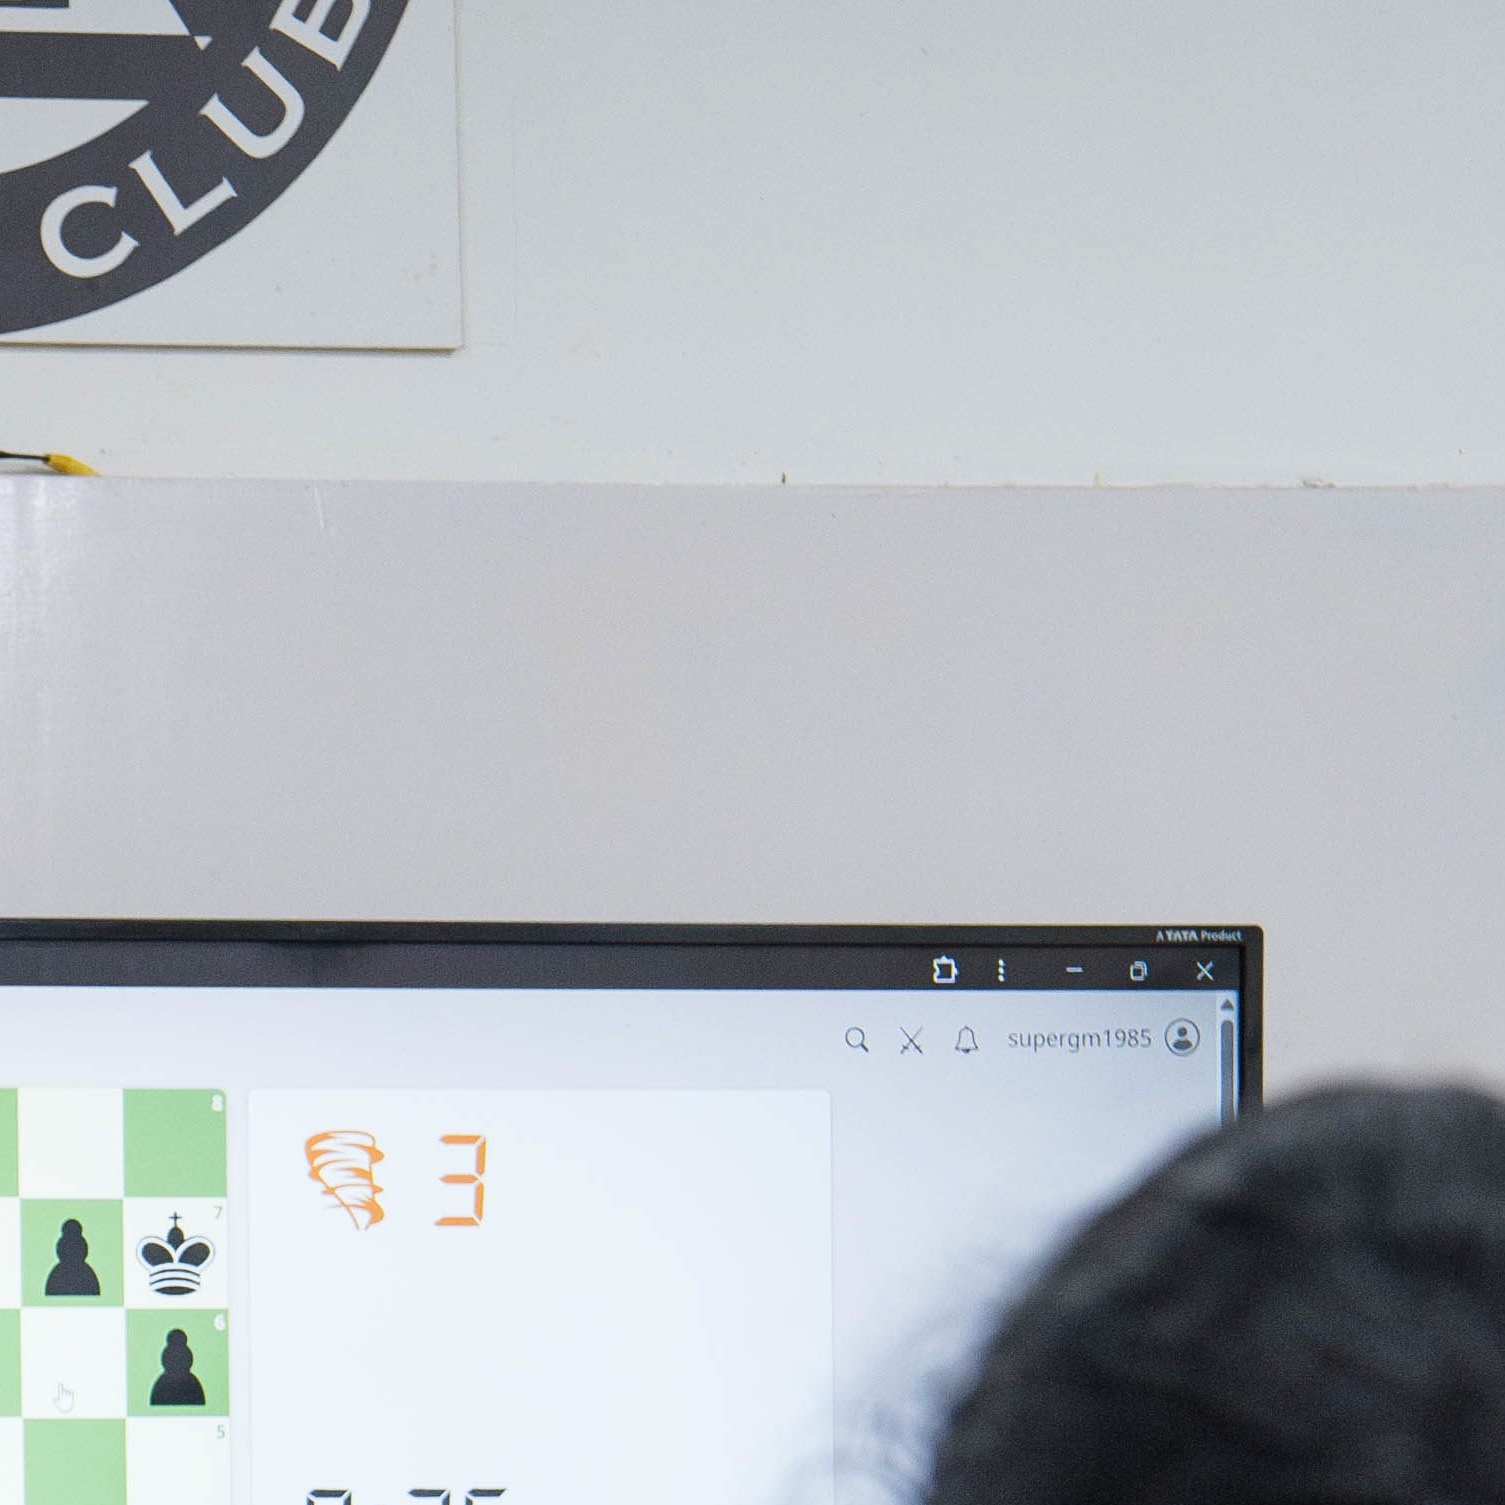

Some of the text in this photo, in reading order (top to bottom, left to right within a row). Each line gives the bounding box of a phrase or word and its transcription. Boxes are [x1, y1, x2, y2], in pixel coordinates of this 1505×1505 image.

[38, 0, 372, 279] CLUB
[1166, 929, 1199, 942] TATA
[1201, 929, 1243, 942] Product
[1007, 1028, 1153, 1053] supergm1985
[435, 1133, 487, 1228] 3
[214, 1204, 224, 1219] 7
[213, 1313, 226, 1331] 6
[216, 1423, 226, 1440] 5
